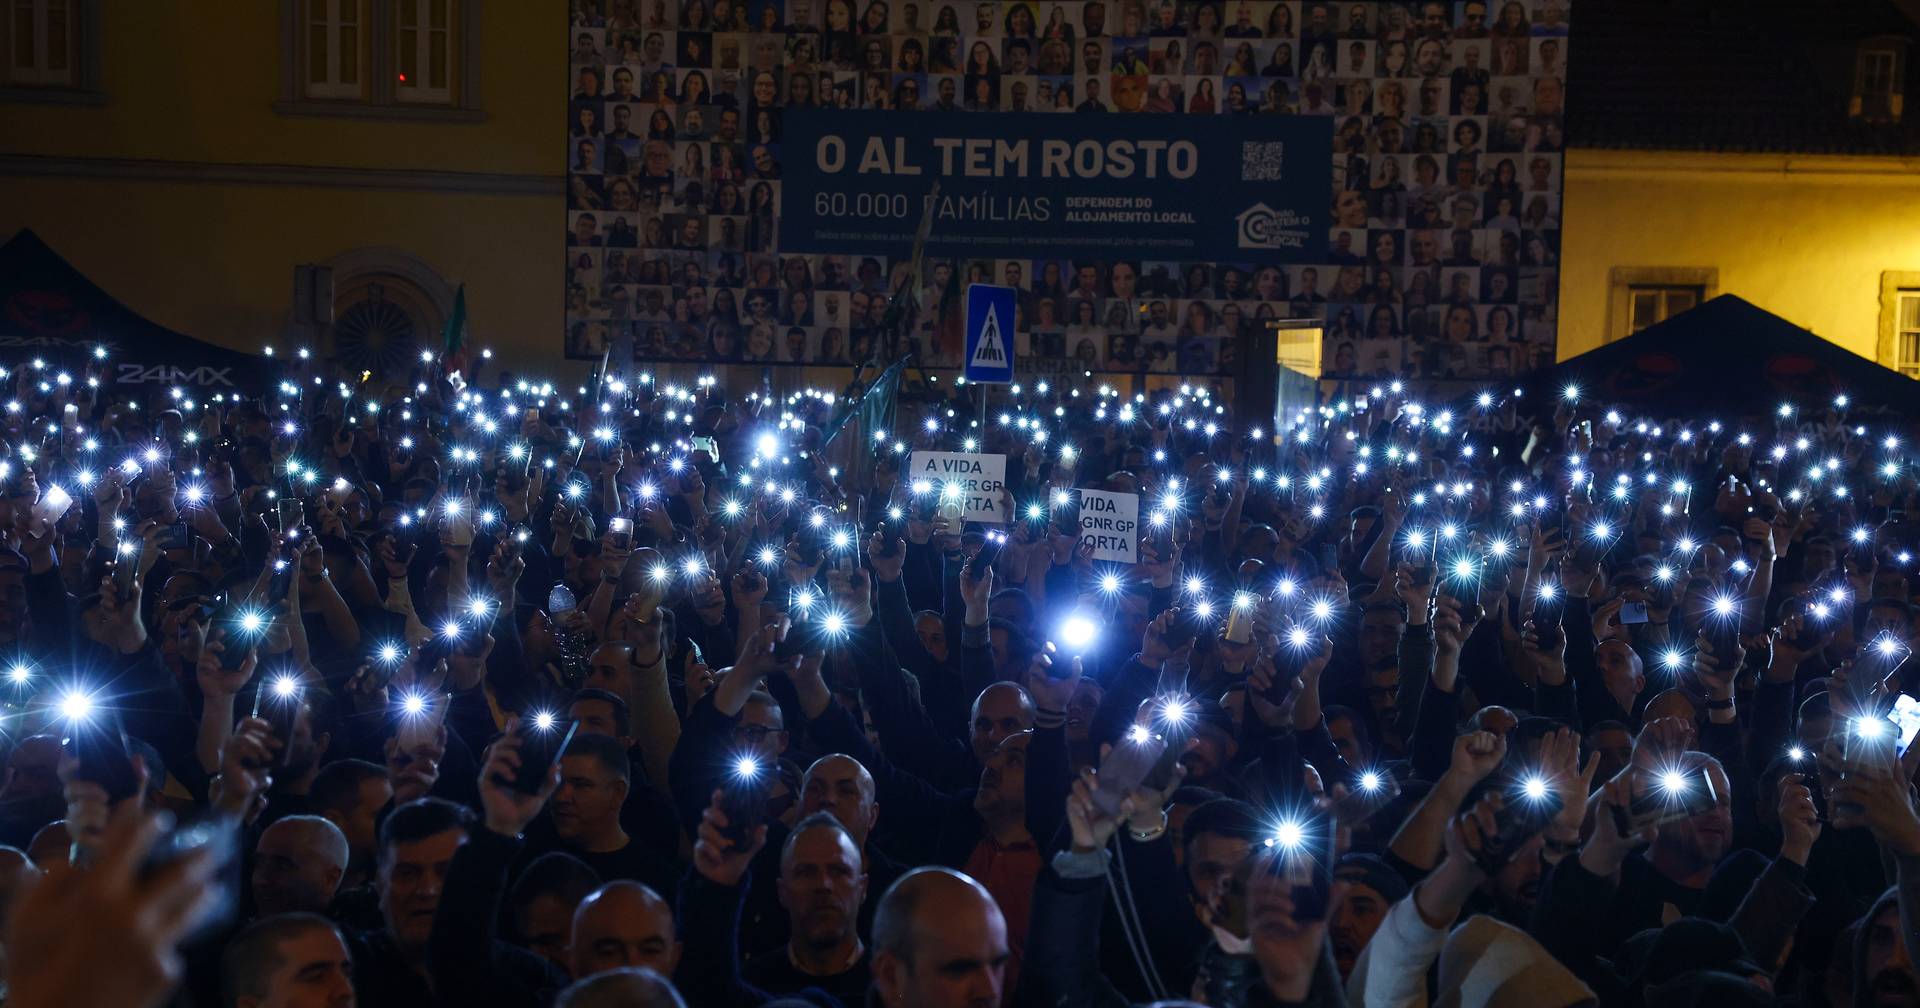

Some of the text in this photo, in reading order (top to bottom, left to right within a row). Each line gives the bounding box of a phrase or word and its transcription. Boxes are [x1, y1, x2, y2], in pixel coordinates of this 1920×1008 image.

[816, 135, 1198, 179] O AL TEM ROSTO
[815, 192, 908, 218] 60.000
[1065, 197, 1152, 208] DEPENDEM DO
[1065, 211, 1195, 224] ALOJAMENTO LOCAL
[116, 363, 234, 387] 24MX
[926, 459, 982, 474] A VIDA
[1081, 496, 1116, 513] VIDA
[1082, 516, 1135, 532] GNR GP
[1080, 534, 1128, 552] ORTA
